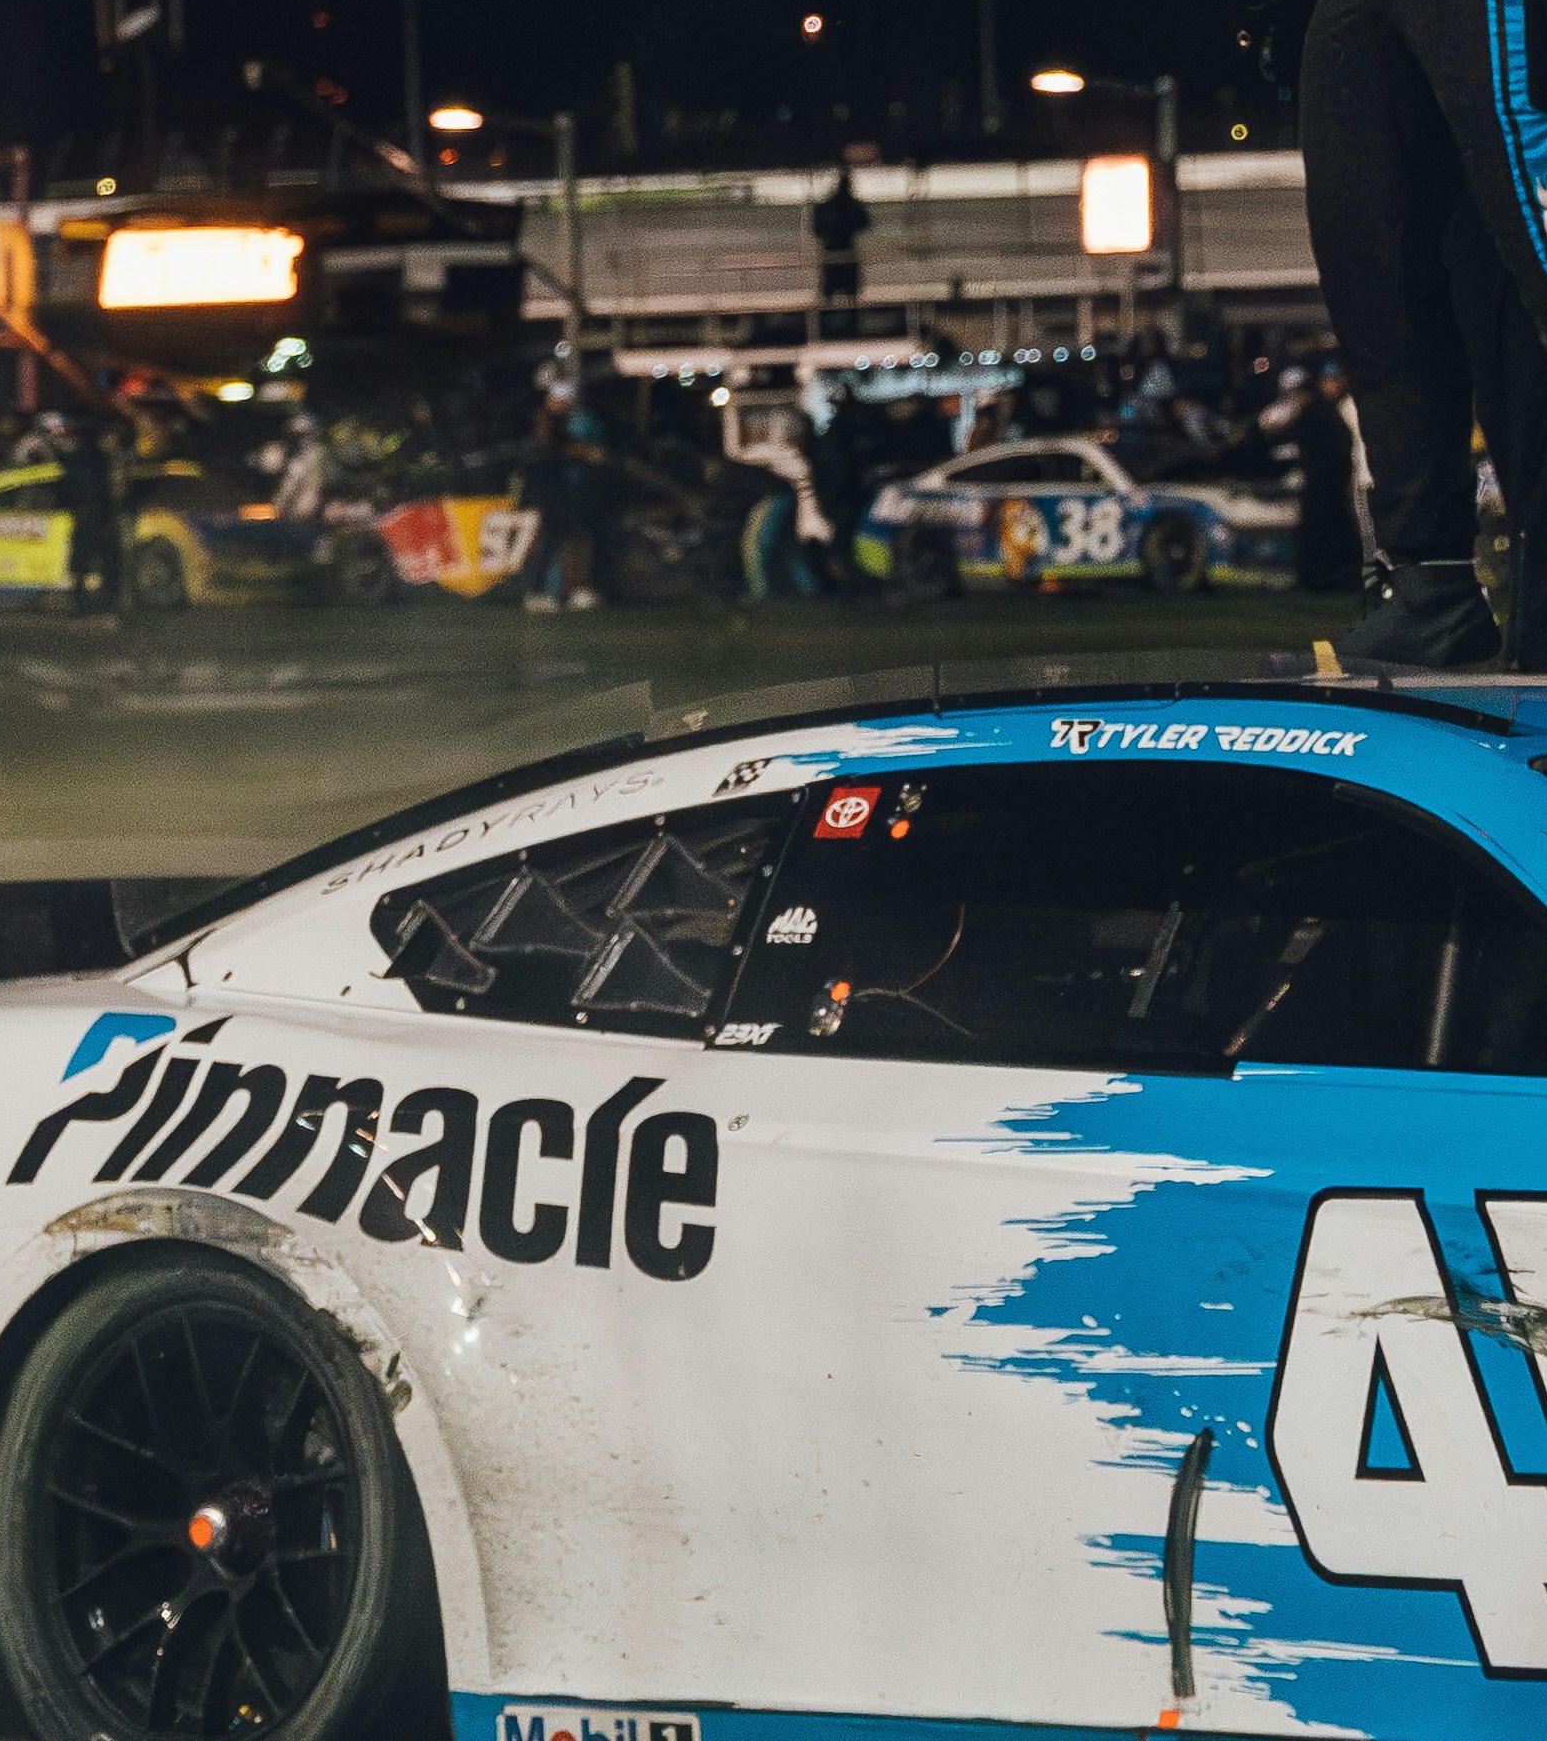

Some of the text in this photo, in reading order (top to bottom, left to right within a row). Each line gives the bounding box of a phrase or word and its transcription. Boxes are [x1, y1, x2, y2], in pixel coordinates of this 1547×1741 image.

[1055, 498, 1124, 562] 38
[1097, 723, 1209, 750] TYLER
[1215, 725, 1368, 756] REDDICK
[766, 932, 813, 944] TOOLS
[6, 1013, 717, 1281] Pinnacle
